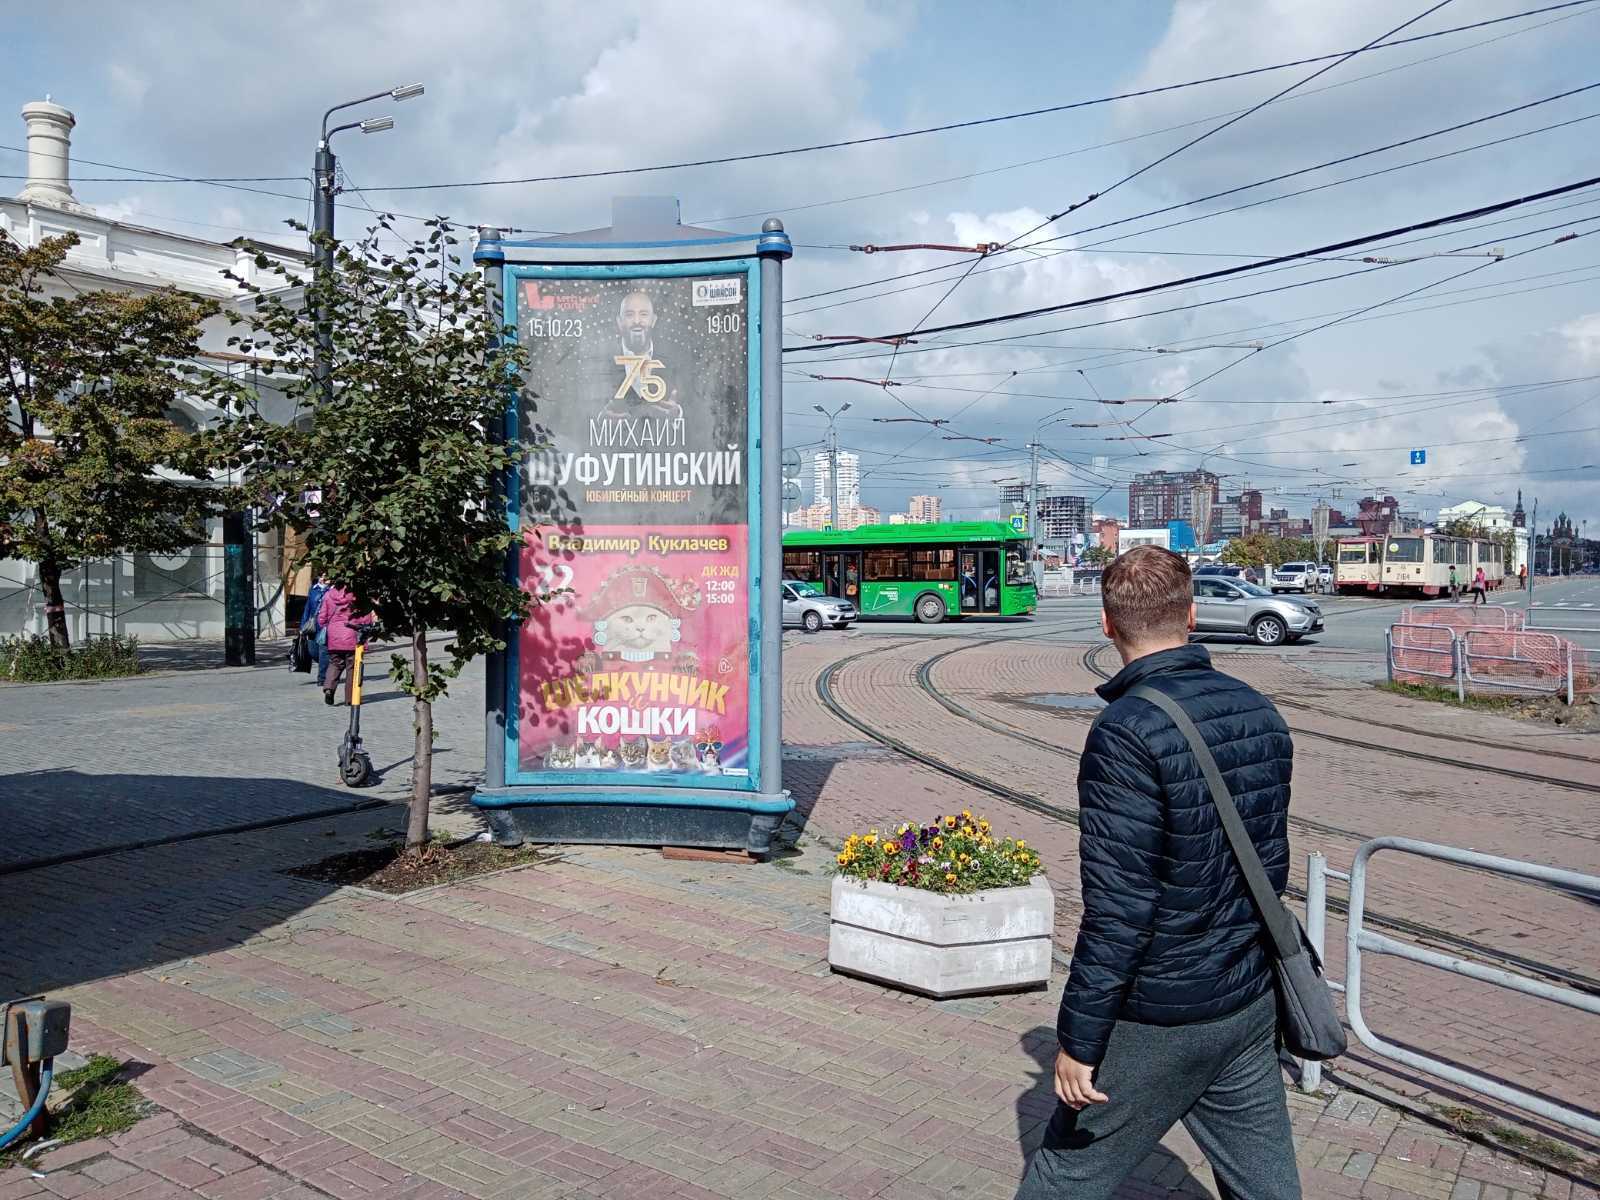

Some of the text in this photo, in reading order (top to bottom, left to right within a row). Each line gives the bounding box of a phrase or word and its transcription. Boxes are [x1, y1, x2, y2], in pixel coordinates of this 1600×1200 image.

[527, 319, 583, 338] 15.10.23
[706, 314, 740, 334] 19:00
[613, 355, 667, 403] 75
[589, 418, 686, 447] МИХАИЛ
[528, 443, 741, 486] ШУФУТИНСКИЙ
[585, 488, 692, 504] ЮБИЛЕЙНЫЙ КОНЦЕРТ
[648, 535, 729, 554] Куклачев
[701, 565, 740, 577] ДК ЖД
[705, 580, 736, 591] 12:00
[705, 593, 735, 604] 15:00
[577, 705, 697, 736] КОШКИ
